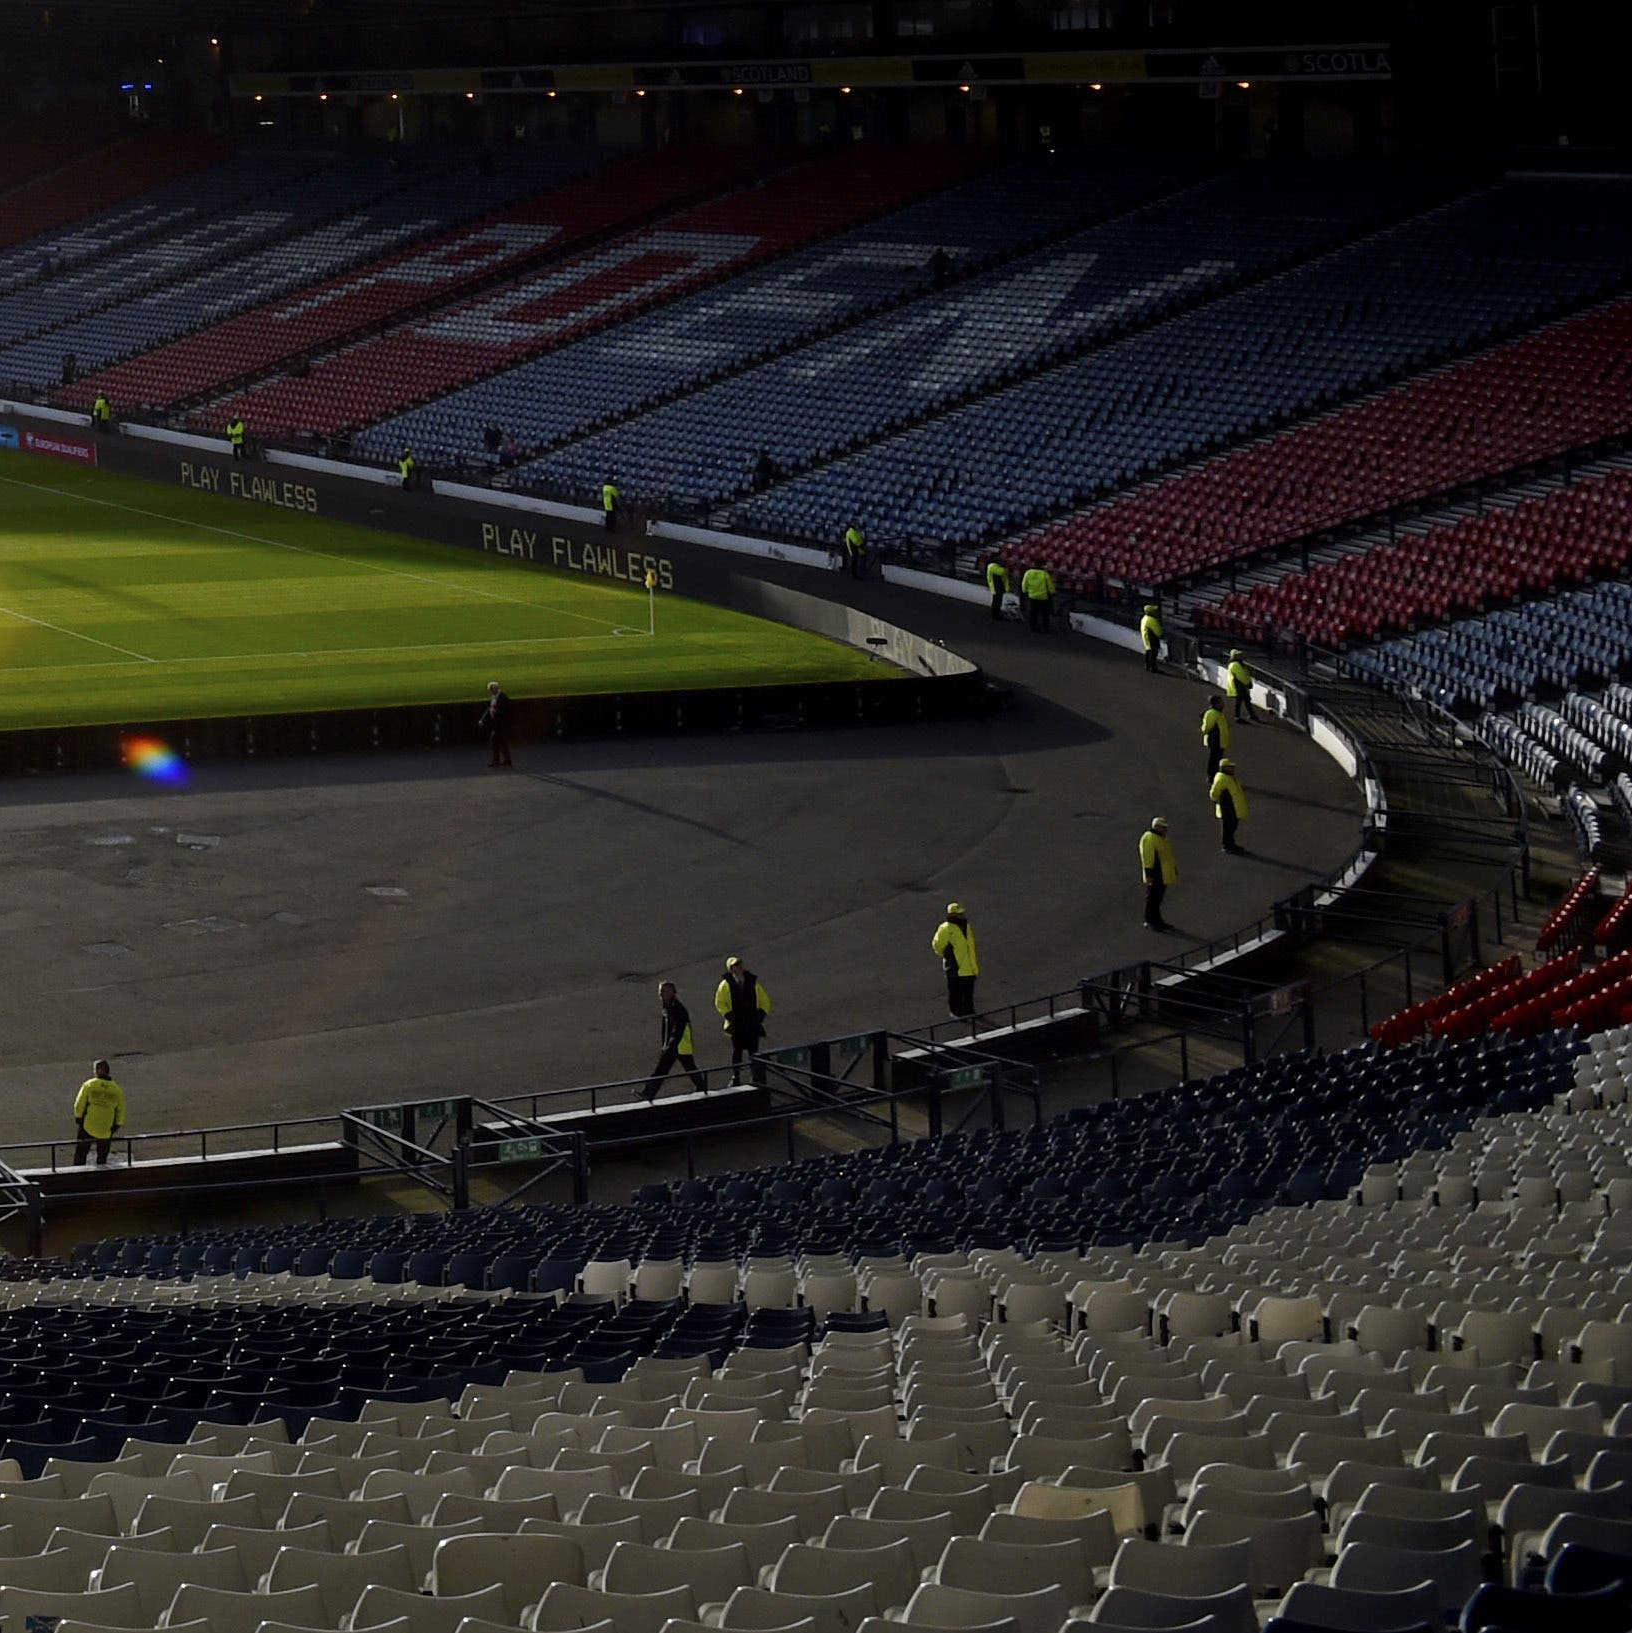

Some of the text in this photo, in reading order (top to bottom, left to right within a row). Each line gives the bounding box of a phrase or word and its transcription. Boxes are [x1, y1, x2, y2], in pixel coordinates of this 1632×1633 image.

[180, 461, 318, 513] PLAY FLAWLESS
[482, 522, 673, 589] PLAY FLAWLESS
